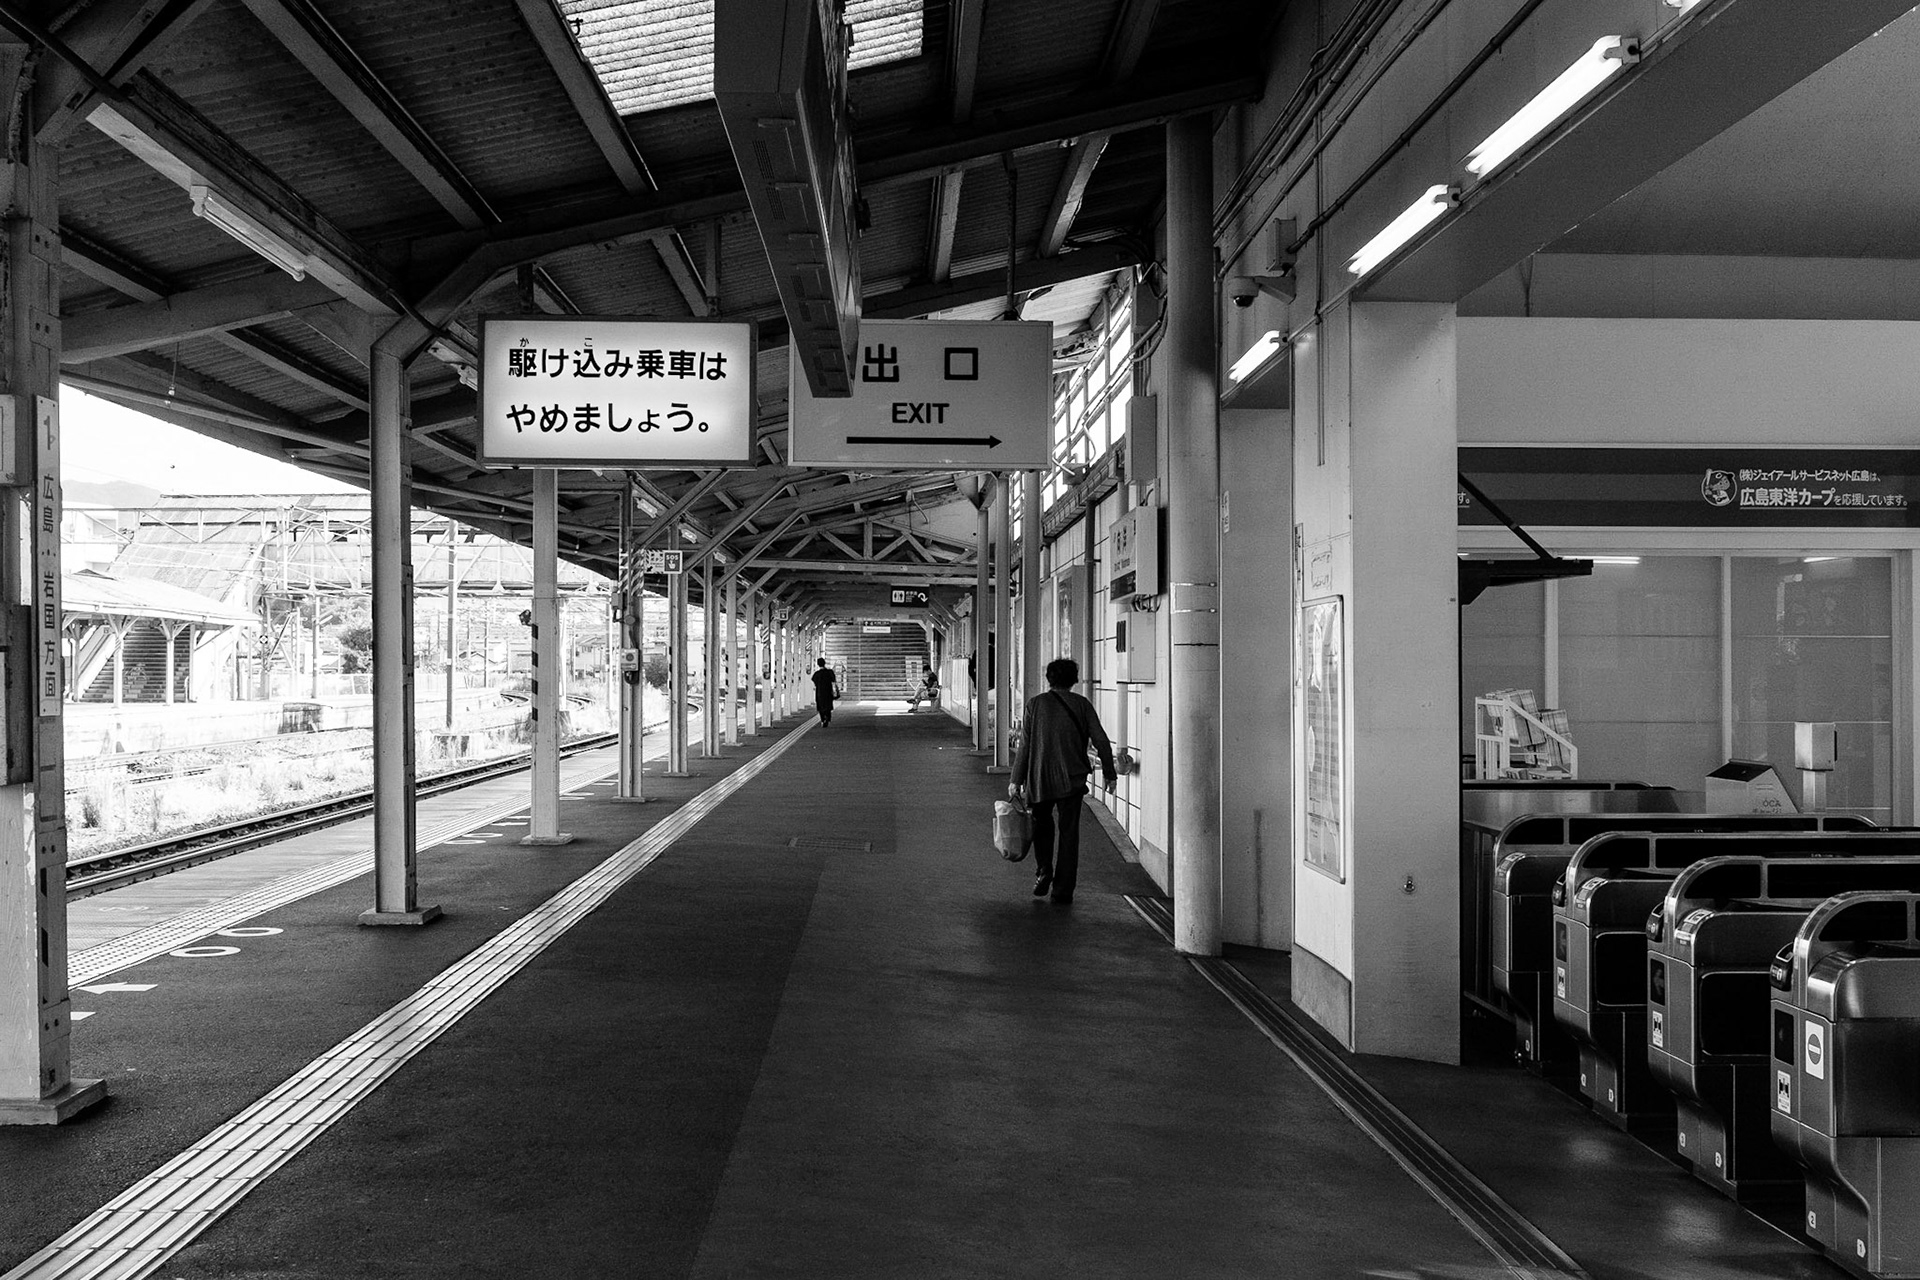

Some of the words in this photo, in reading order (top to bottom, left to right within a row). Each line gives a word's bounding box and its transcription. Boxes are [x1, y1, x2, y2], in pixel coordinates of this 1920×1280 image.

[519, 337, 530, 348] か
[508, 348, 727, 381] 駆け込み乗車は
[862, 343, 980, 382] 出口
[507, 402, 710, 434] やめましょう。
[891, 403, 951, 424] EXIT
[1739, 487, 1909, 507] 広島東洋カープを応援しています。
